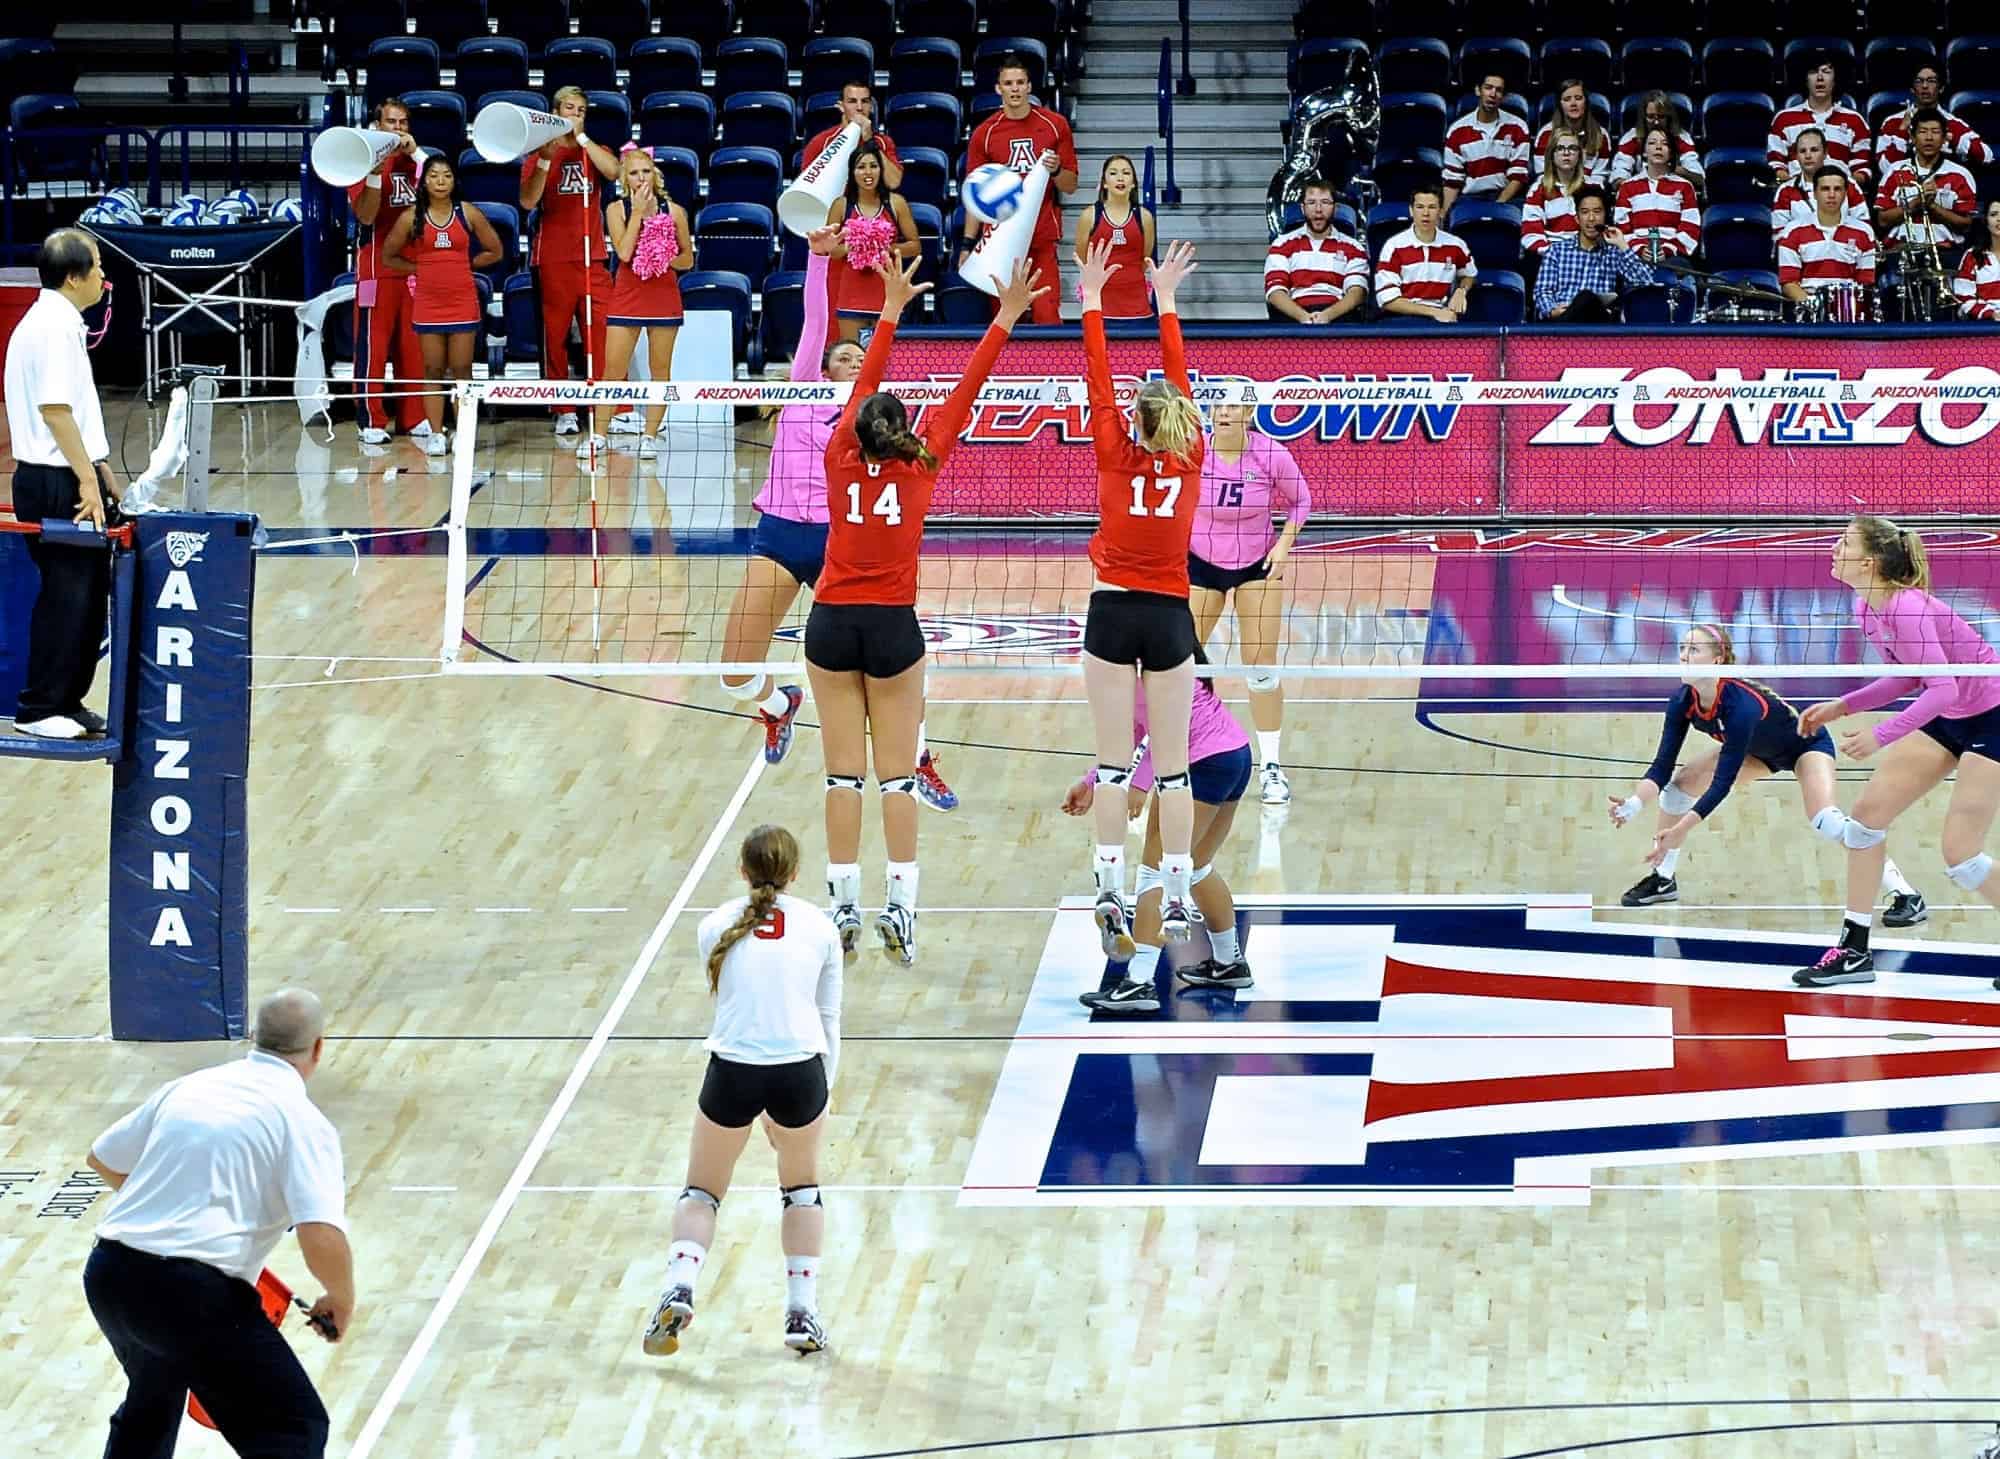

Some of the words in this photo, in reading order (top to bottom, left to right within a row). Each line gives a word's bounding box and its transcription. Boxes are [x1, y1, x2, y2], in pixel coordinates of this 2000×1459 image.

[803, 133, 849, 184] BEARDOWN
[170, 247, 216, 259] molten
[489, 386, 651, 400] ARIZONAVOLLEYBALL
[694, 387, 836, 400] ARIZONAWILDCATS
[1272, 387, 1433, 400] ARIZONAVOLLEYBALL
[1477, 387, 1620, 400] ARIZONAWILDCATS
[1664, 386, 1827, 399] ARIZONAVOLLEYBALL
[846, 481, 901, 526] 14
[1128, 475, 1182, 518] 17
[1216, 482, 1244, 507] 15
[150, 570, 199, 947] ARIZONA
[753, 907, 785, 940] 9
